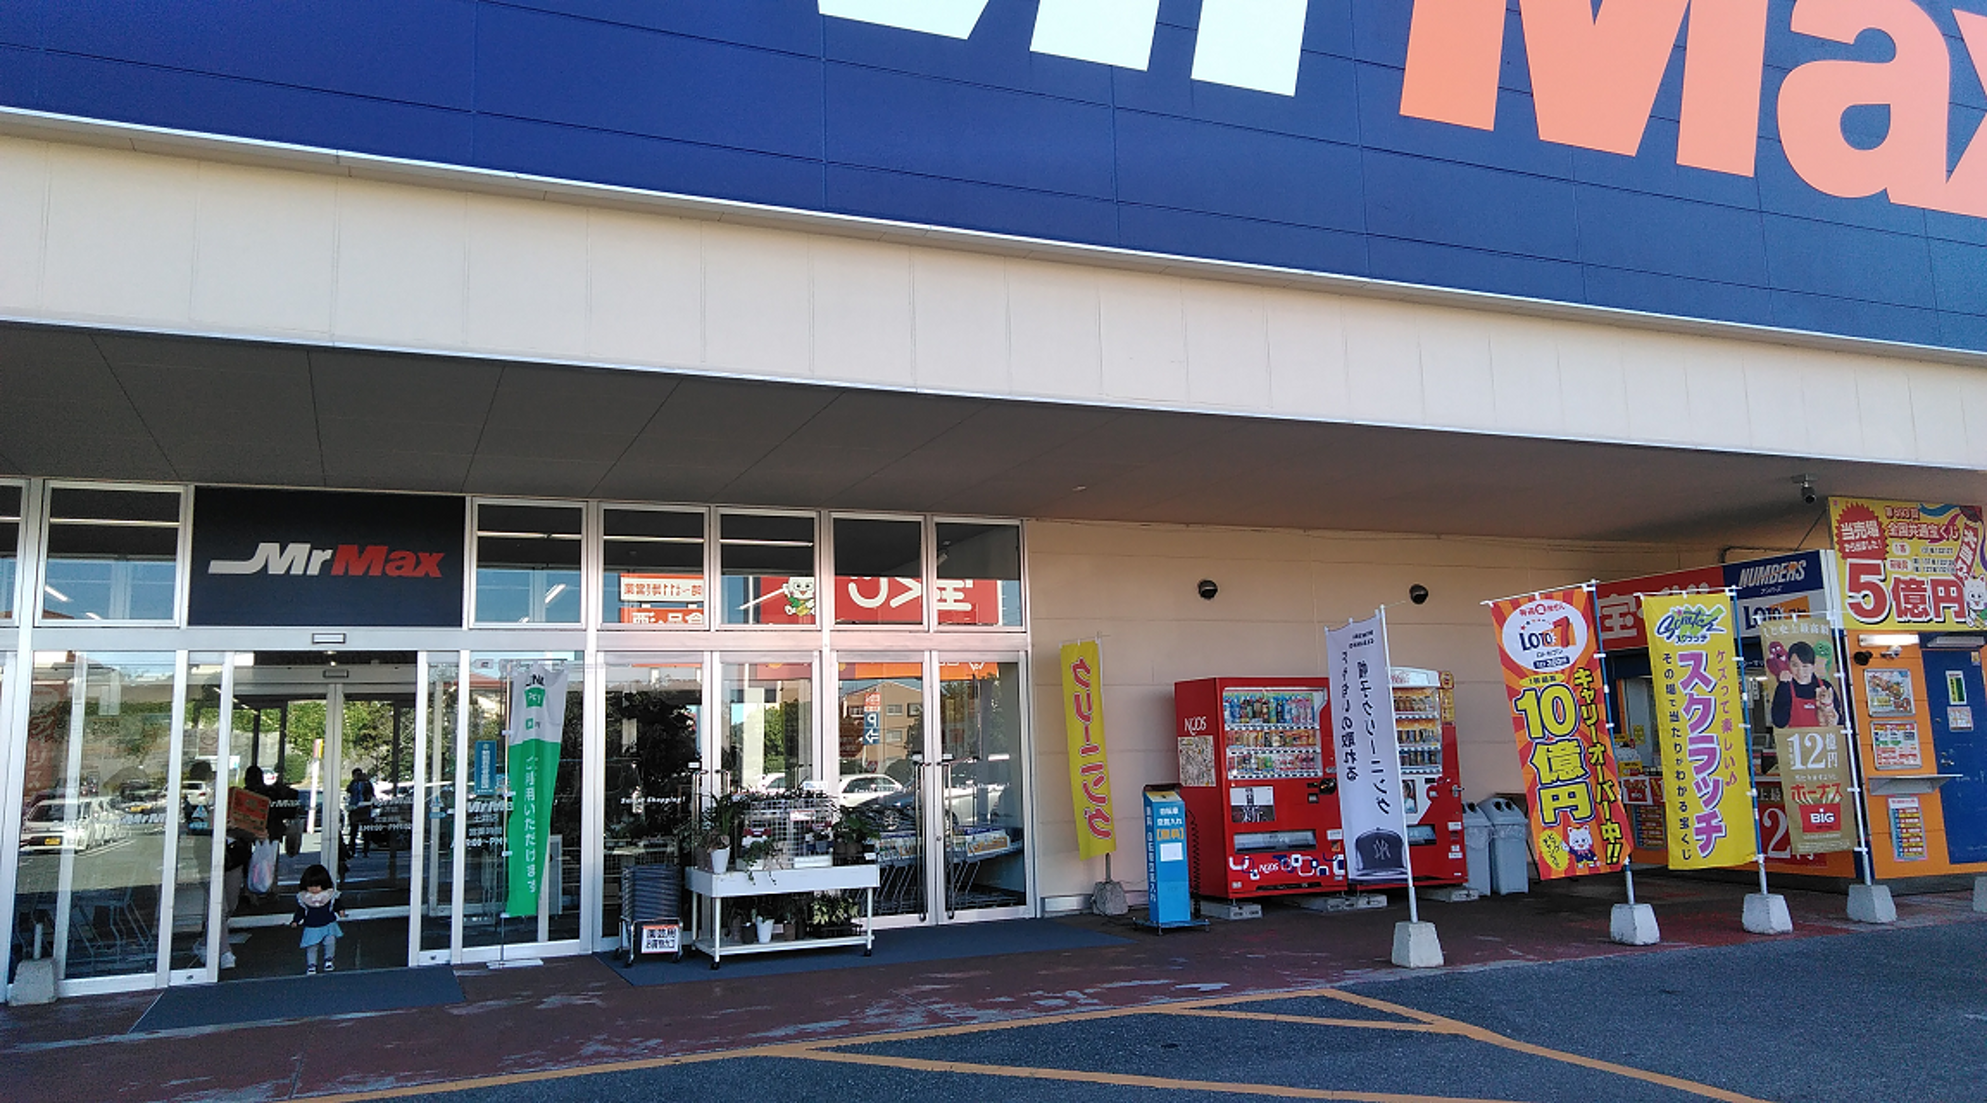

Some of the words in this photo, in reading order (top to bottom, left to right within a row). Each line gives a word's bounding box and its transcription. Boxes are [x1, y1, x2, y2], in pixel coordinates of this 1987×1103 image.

[1841, 521, 1879, 540] 当売場
[208, 543, 445, 577] MrMax
[1738, 560, 1807, 587] NUMBERS
[1846, 559, 1966, 624] 5億円
[1513, 682, 1596, 828] 10億円
[1677, 650, 1726, 858] スクラッチ
